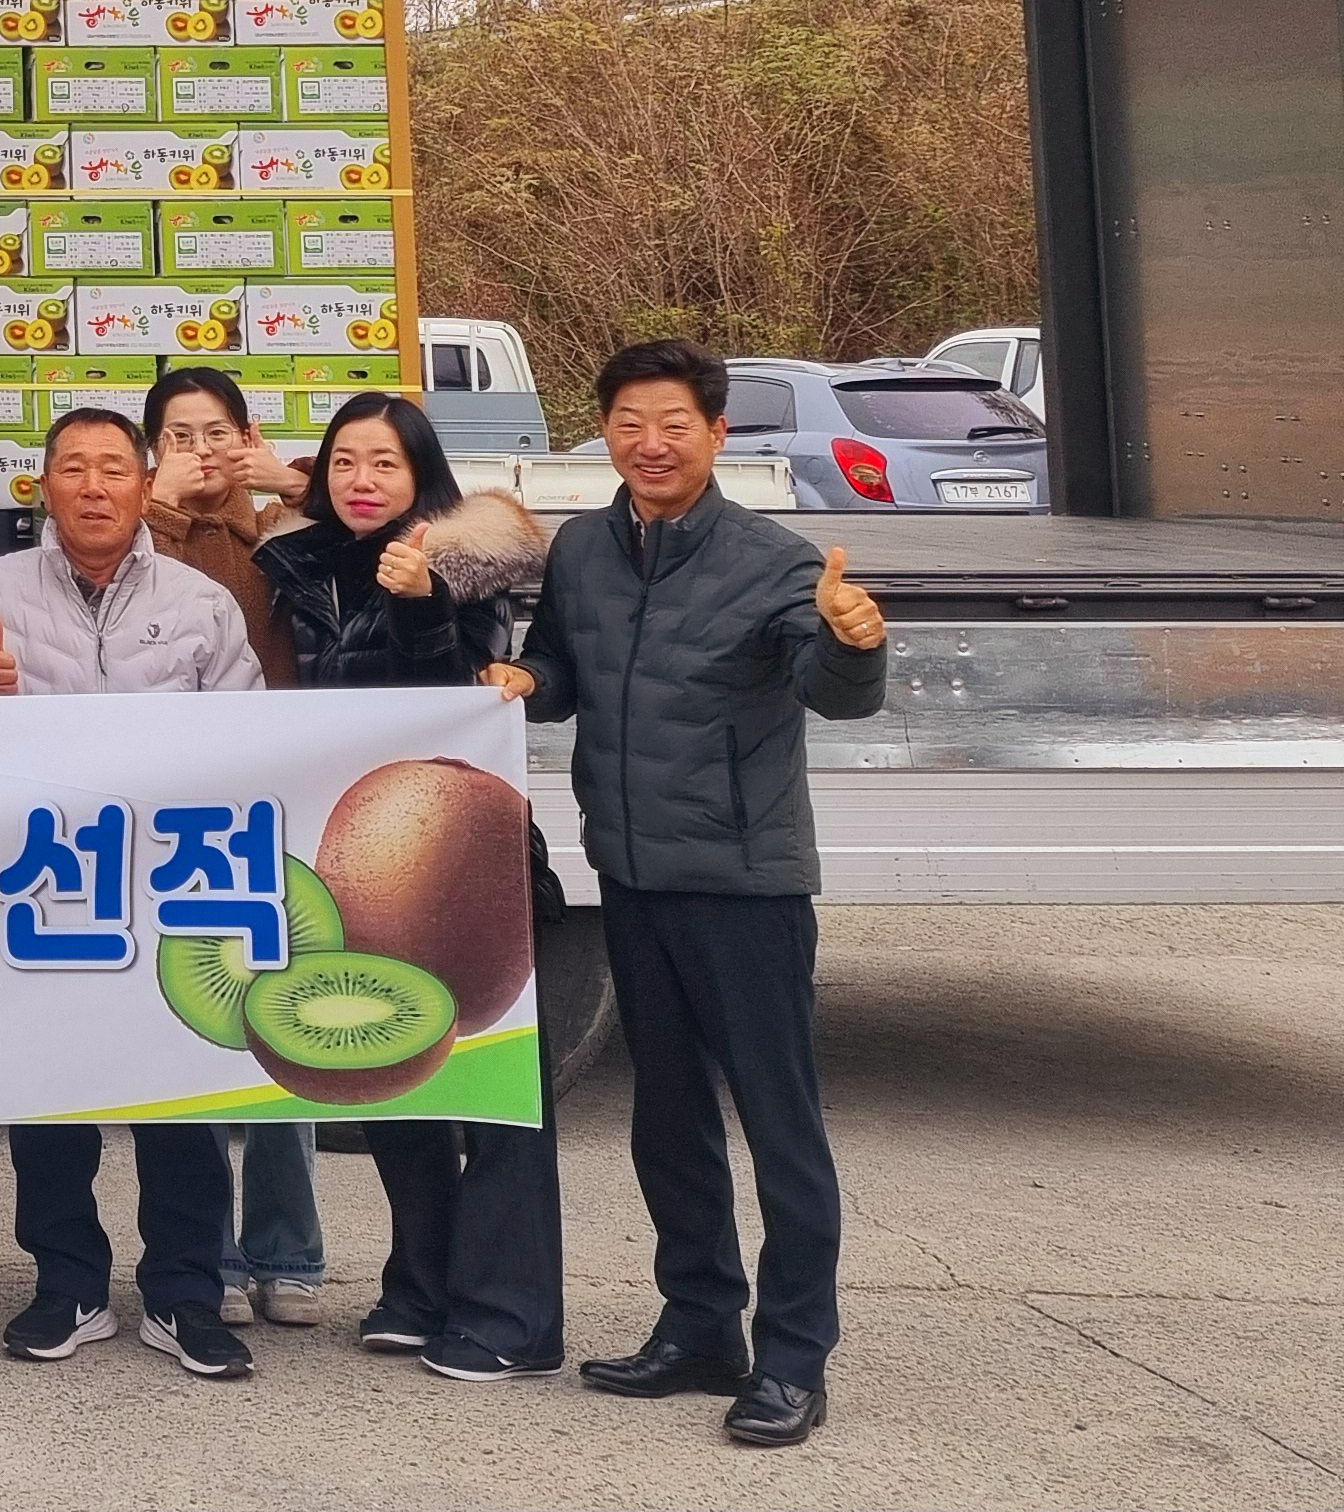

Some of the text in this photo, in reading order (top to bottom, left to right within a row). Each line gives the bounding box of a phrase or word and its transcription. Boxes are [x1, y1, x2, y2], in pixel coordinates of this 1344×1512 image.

[143, 147, 195, 163] 하동키위
[314, 147, 365, 162] 하동키위
[150, 303, 202, 319] 하동키위
[321, 302, 372, 318] 하동키위
[985, 485, 1018, 498] 2167
